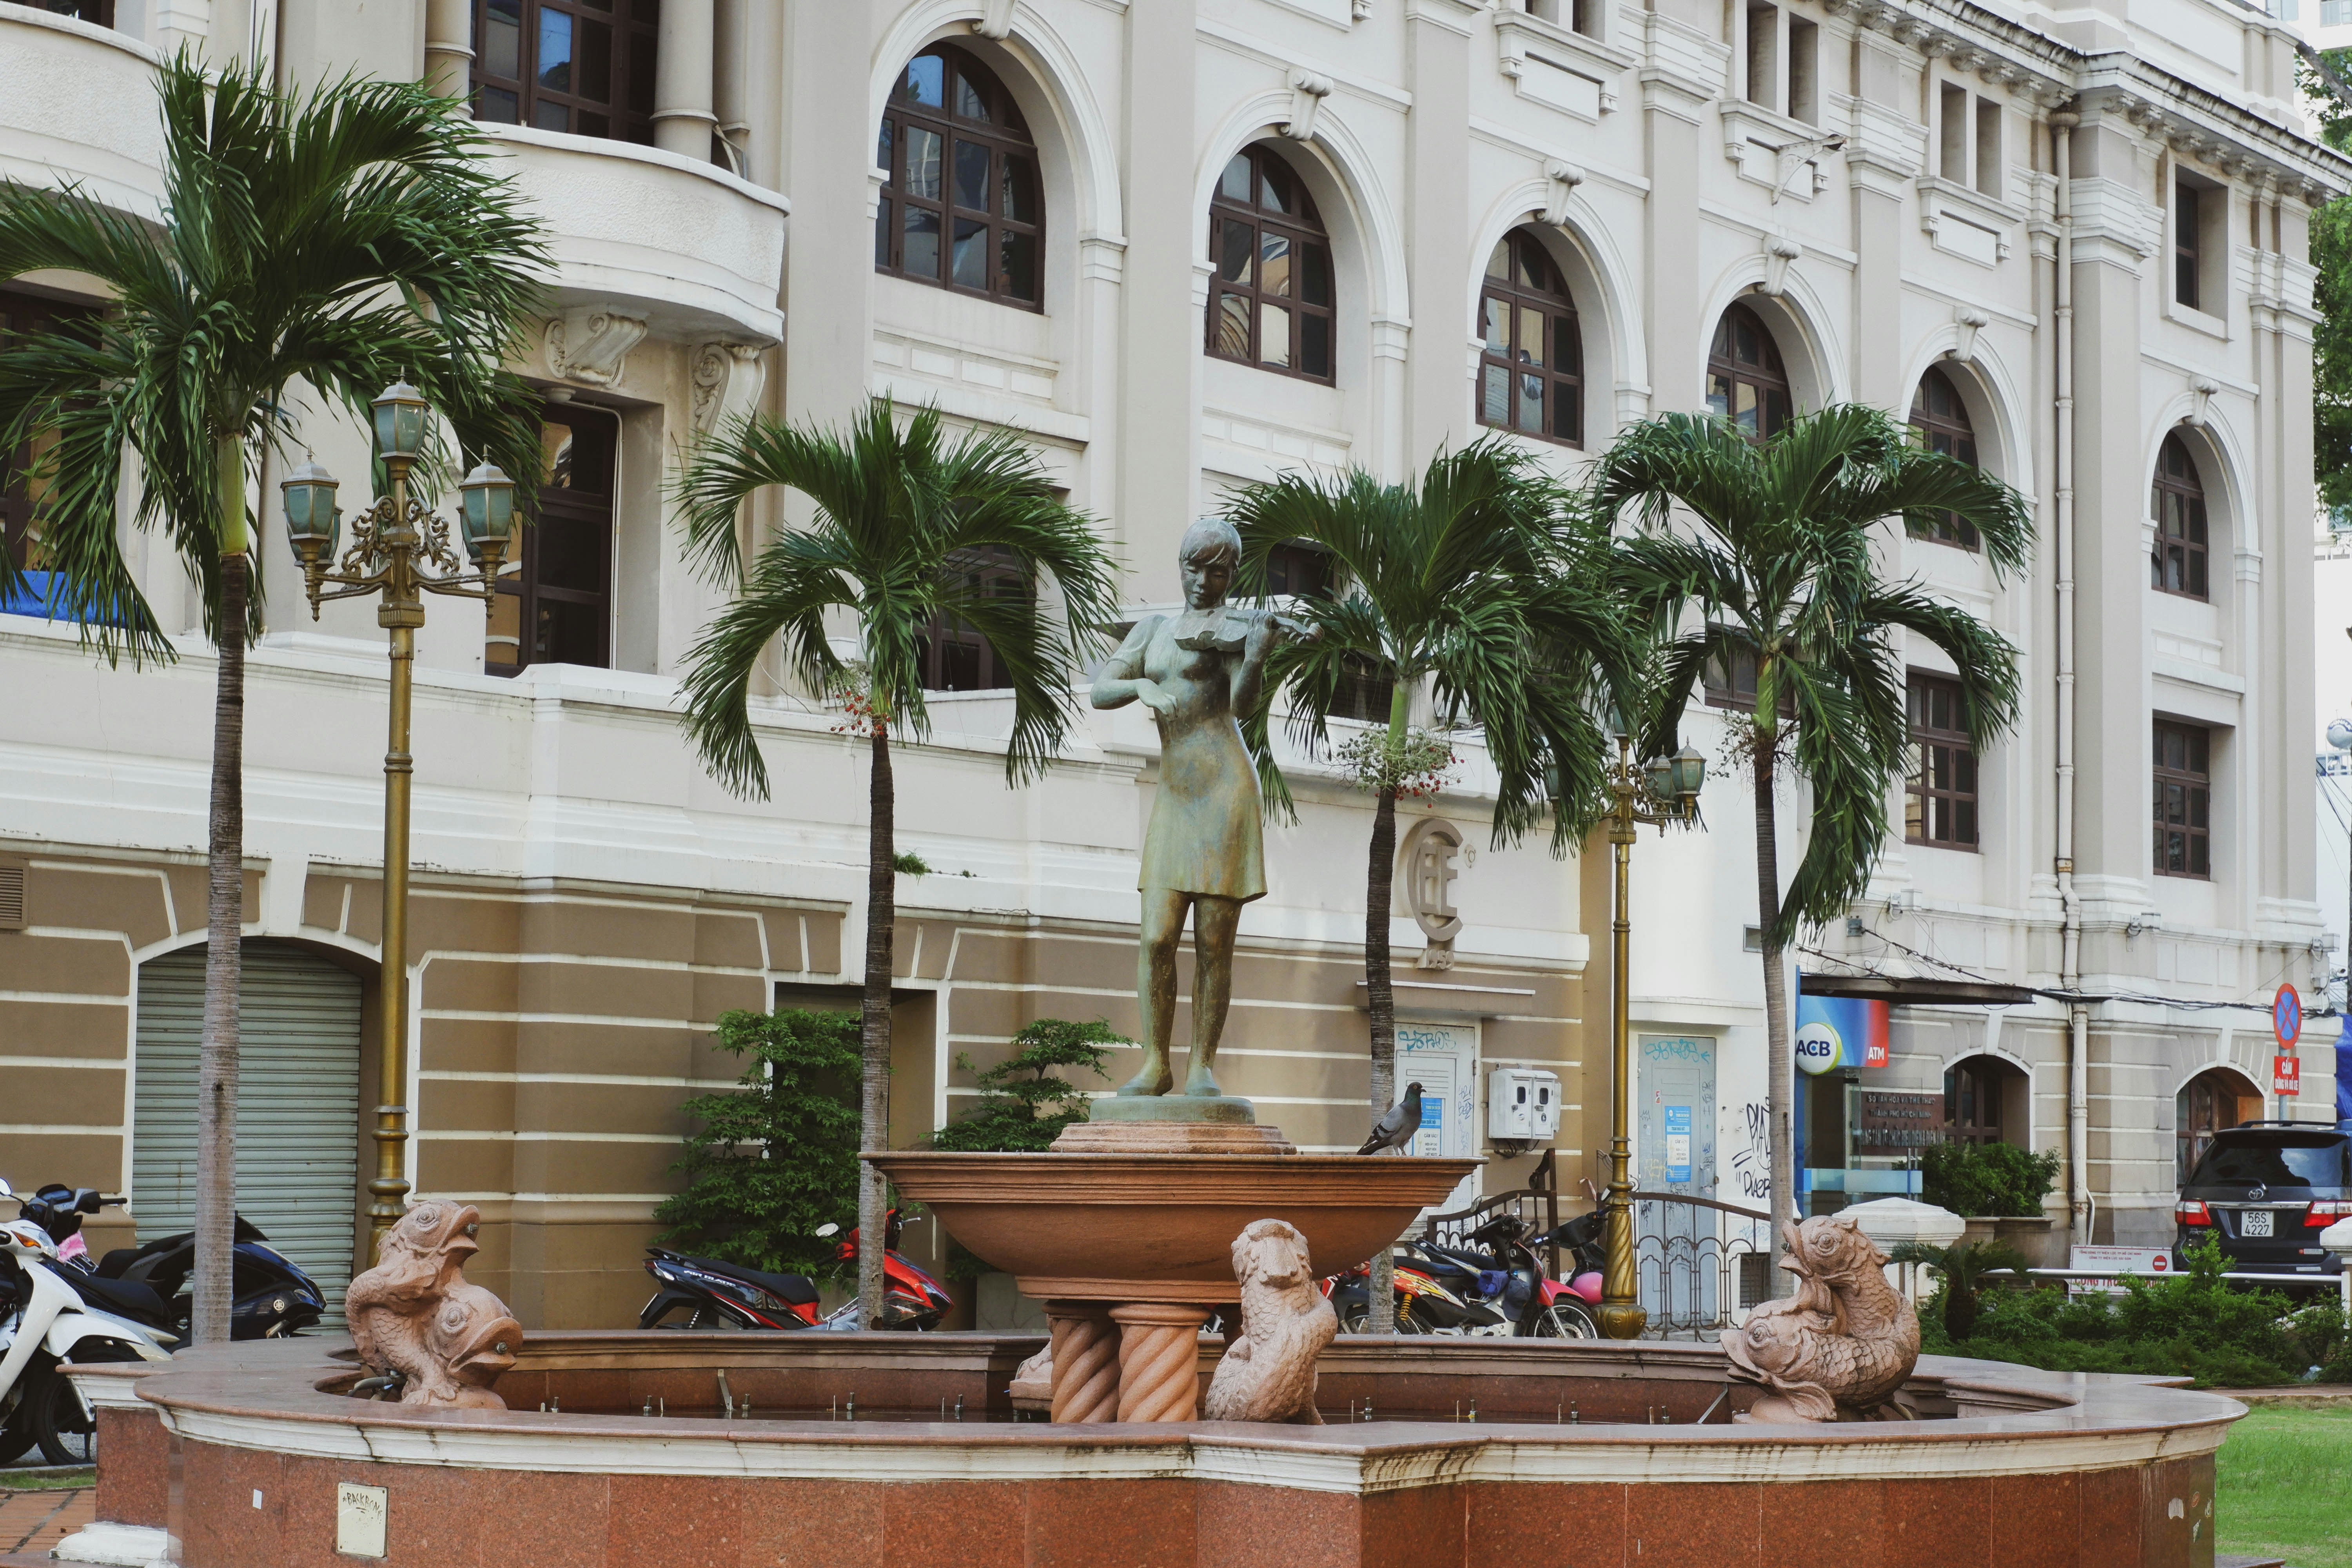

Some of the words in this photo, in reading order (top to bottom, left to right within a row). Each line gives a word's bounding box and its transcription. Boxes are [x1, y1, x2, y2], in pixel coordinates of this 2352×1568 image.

[1796, 1040, 1831, 1056] ACB
[1868, 1046, 1885, 1060] ATM
[2248, 1212, 2267, 1223] 56S
[2245, 1225, 2270, 1235] 4227
